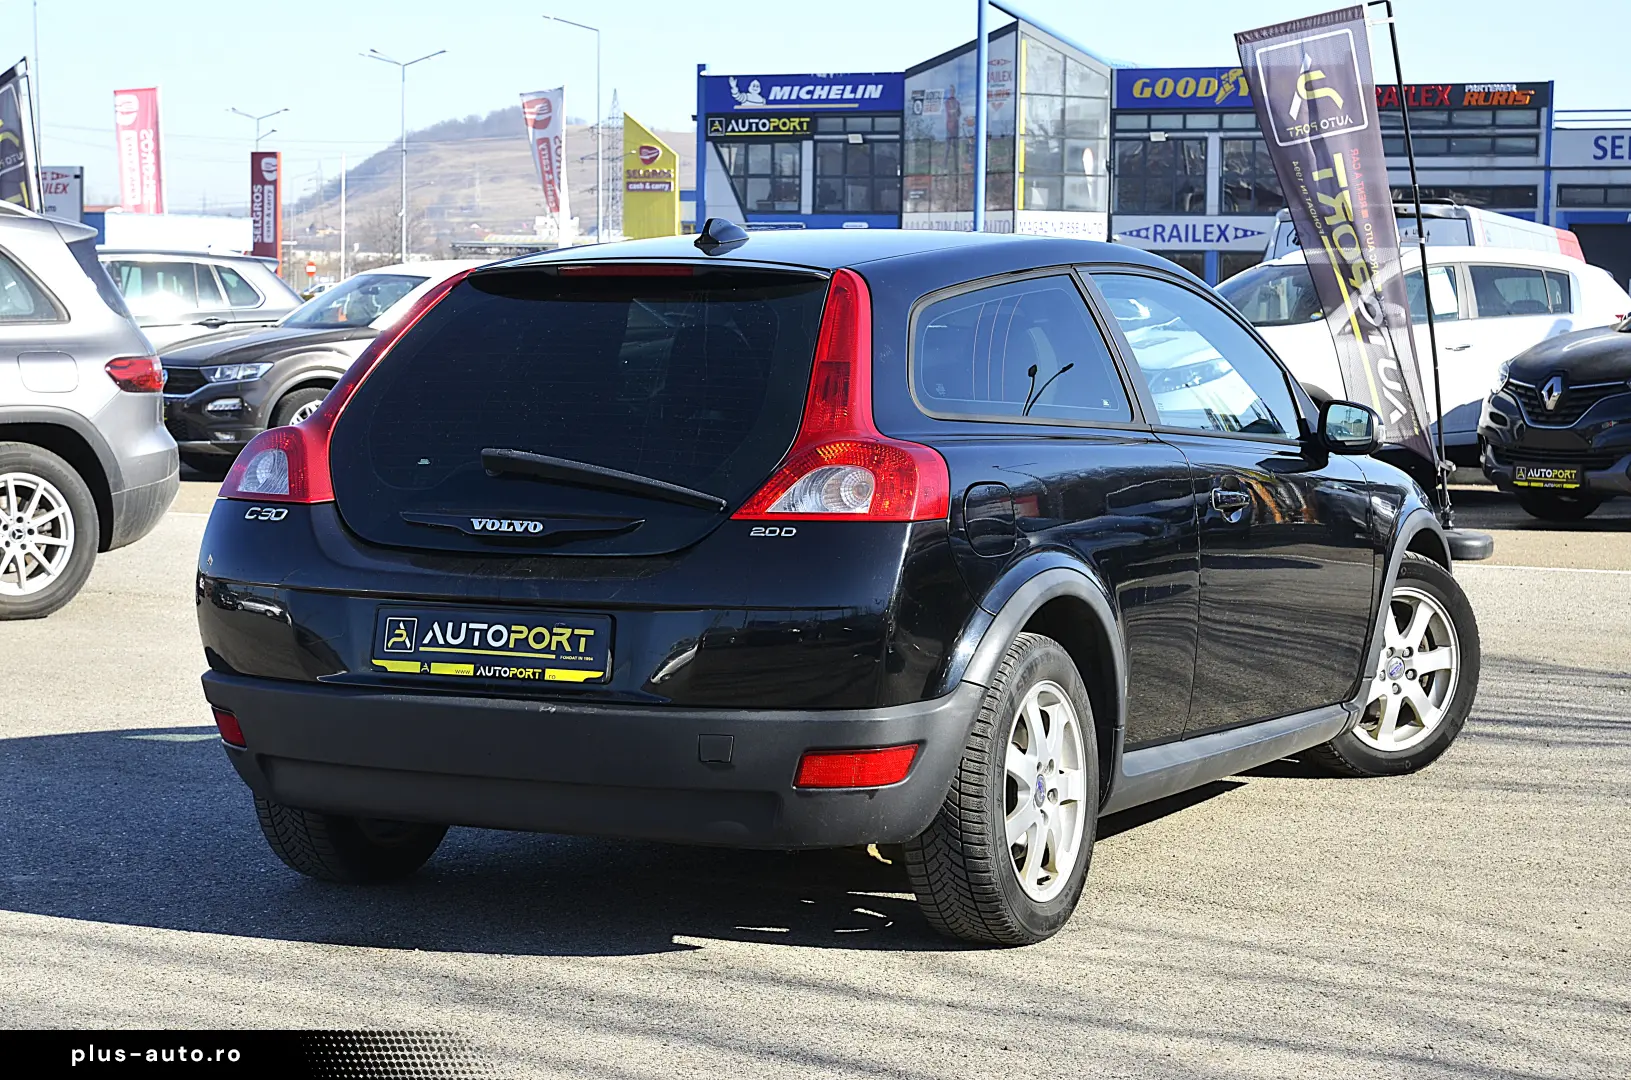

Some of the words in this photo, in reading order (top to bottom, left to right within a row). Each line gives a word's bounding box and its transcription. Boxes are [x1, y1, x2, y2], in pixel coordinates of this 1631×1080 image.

[768, 84, 884, 101] MICHELIN
[1132, 77, 1250, 99] GOODY
[1465, 84, 1517, 93] PARTENER
[1376, 85, 1452, 107] ALEX
[1463, 90, 1531, 107] RURIS
[727, 117, 811, 132] AUTOPORT
[1592, 135, 1631, 161] SE
[626, 169, 673, 178] SELGROS
[43, 183, 69, 195] ILEX
[651, 183, 669, 191] carry
[253, 184, 263, 243] SELGROS
[954, 220, 974, 232] PIES
[1153, 224, 1230, 243] RAILEX
[1527, 468, 1577, 479] AUTOPORT
[244, 506, 289, 521] C30
[470, 518, 544, 533] VOLVO
[422, 621, 595, 652] AUTOPORT
[476, 665, 542, 680] AUTOPORT
